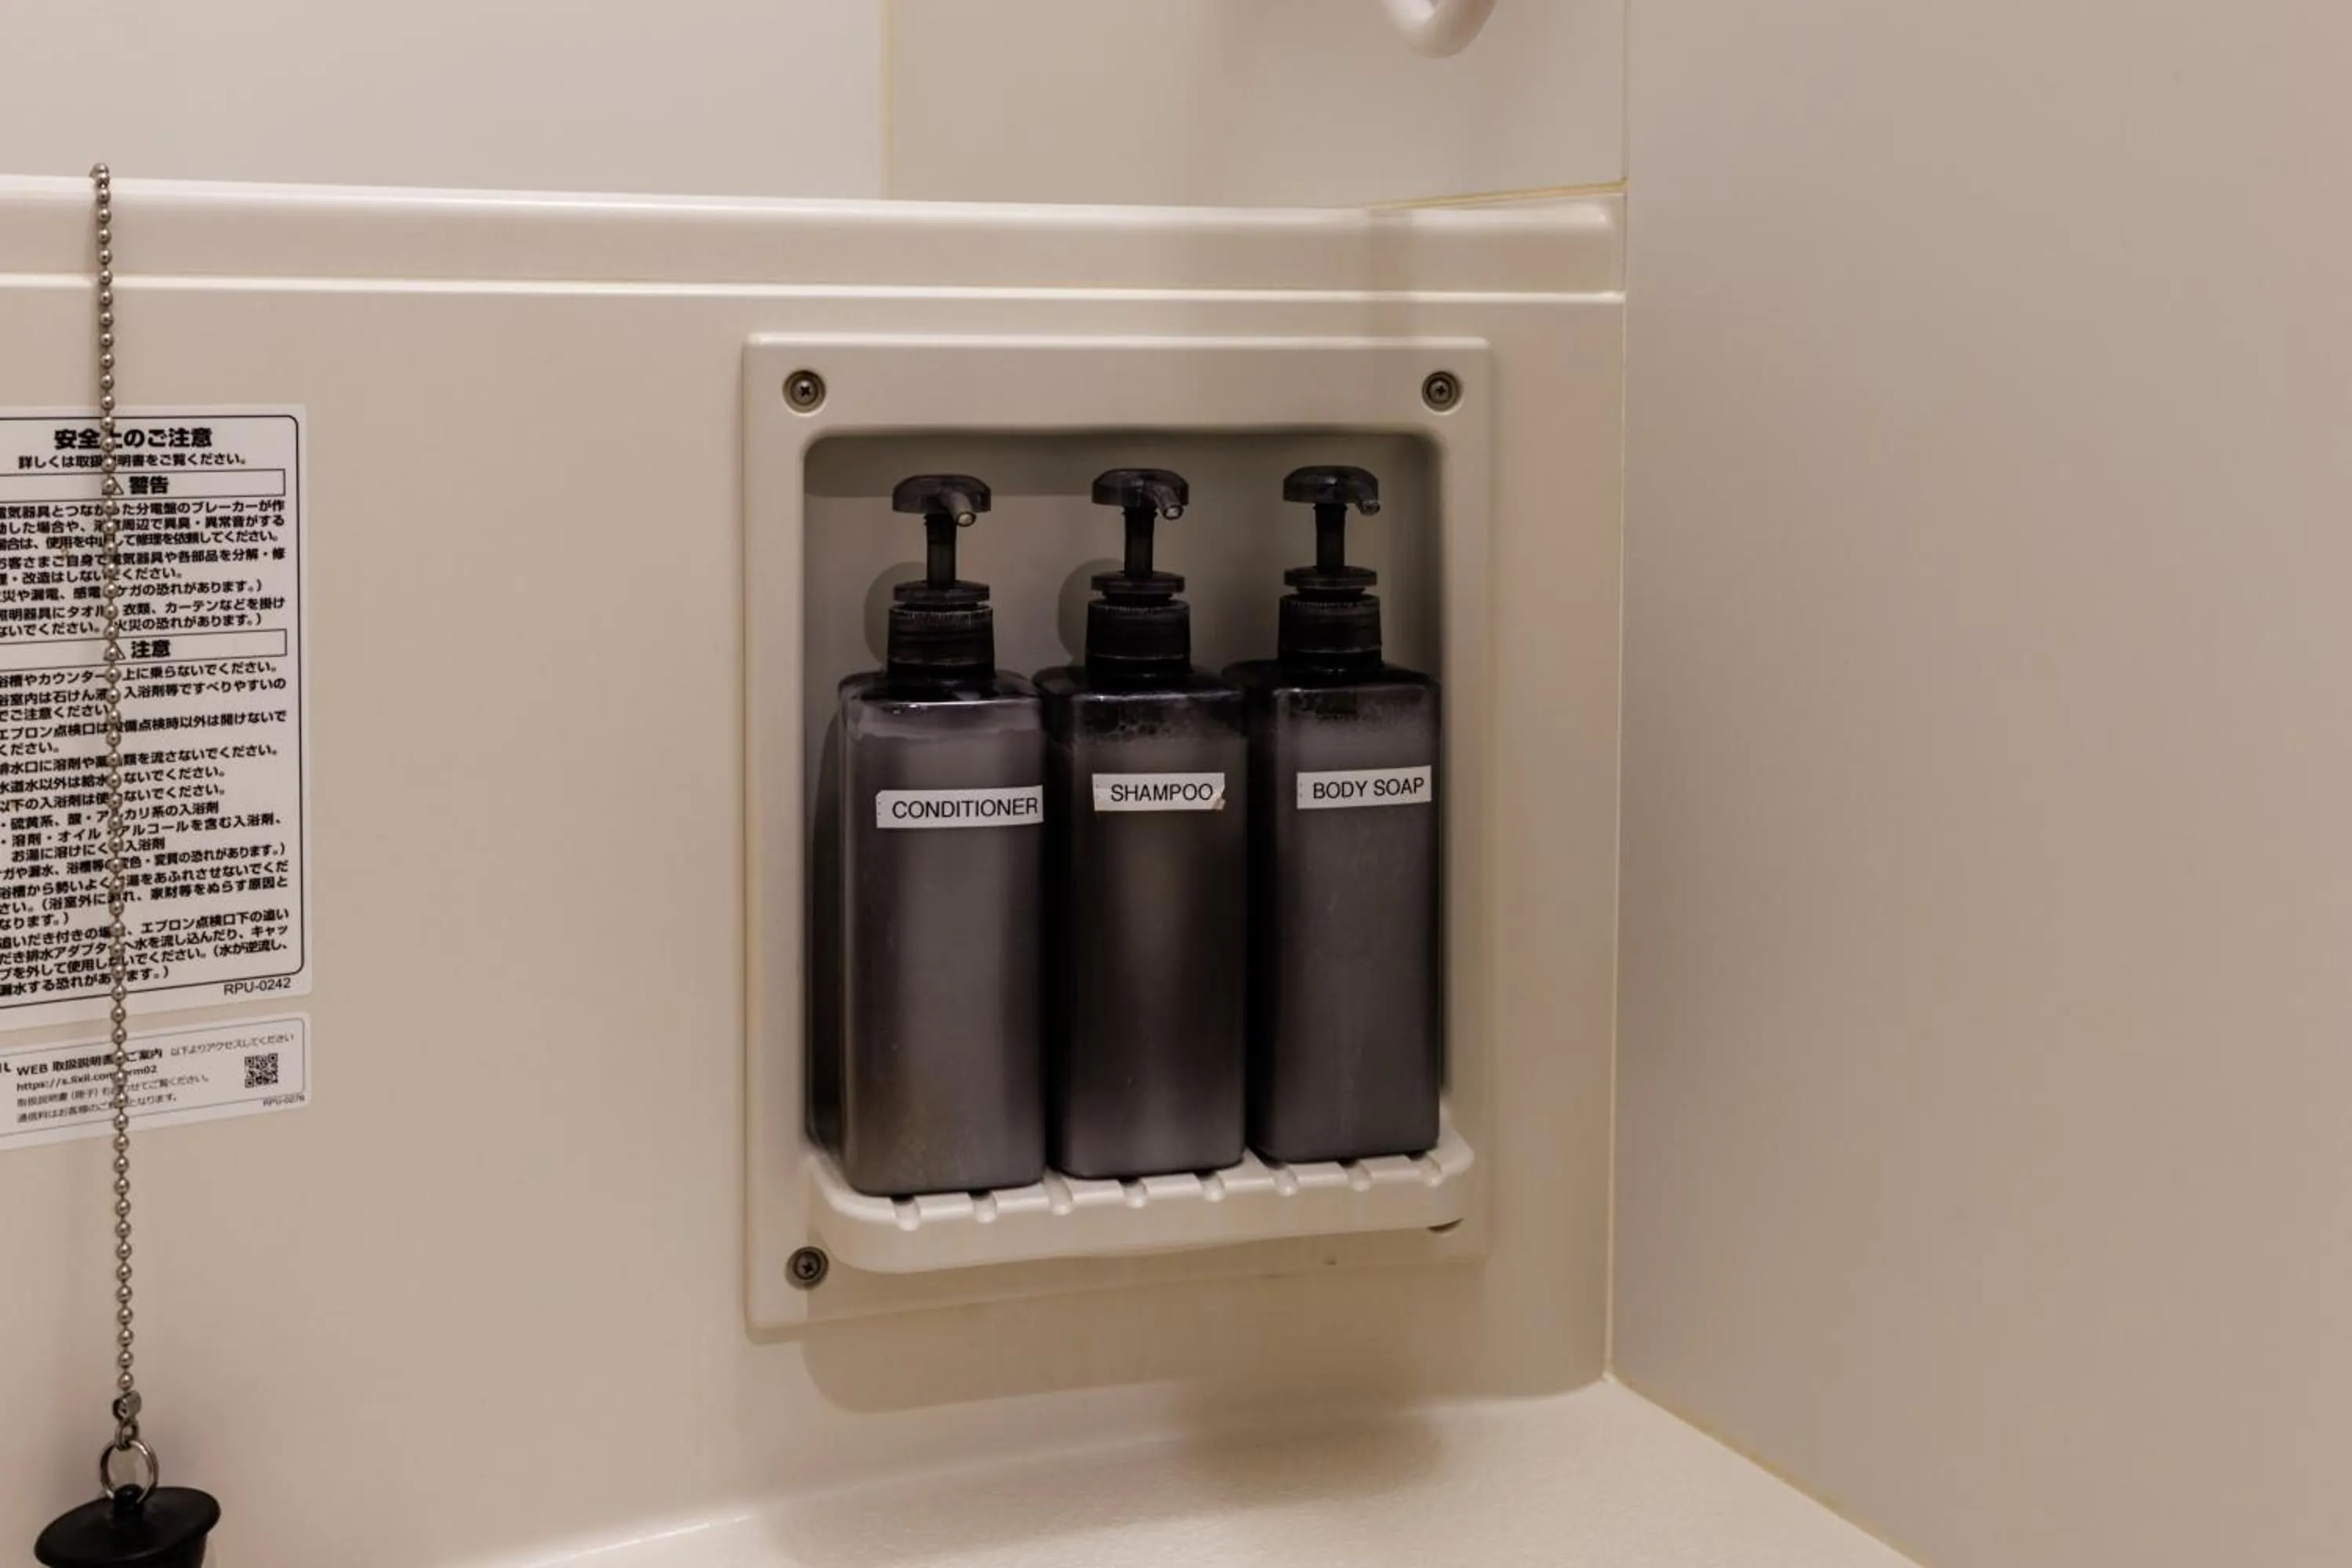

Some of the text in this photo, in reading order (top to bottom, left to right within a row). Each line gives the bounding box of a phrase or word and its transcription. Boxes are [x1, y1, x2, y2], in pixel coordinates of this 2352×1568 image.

[18, 452, 245, 470] 詳しくは取扱明書をご覧ください。
[129, 475, 169, 495] 警告
[0, 499, 285, 519] 気器具とつながた分電盤のブレーカーが作
[0, 597, 285, 621] 照明器具にタオル衣類、カーテンなどを掛け
[131, 639, 170, 657] 注意
[0, 661, 276, 688] 浴槽やカウンター上に乗らないでください。
[0, 677, 286, 706] 浴室内は石けん液入浴剤等ですべりやすいの
[0, 744, 278, 775] 排水口に溶剤や薬類を流さないでください。
[0, 766, 225, 794] 水道水以外は給水ないでください。
[1111, 783, 1214, 802] SHAMPOO
[1313, 777, 1425, 799] BODY SOAP
[0, 784, 225, 812] 以下の入浴剤は使ないでください。
[892, 797, 1038, 819] CONDITIONER
[2, 800, 219, 830] ・硫黄系、酸・アカリ系の入浴剤
[12, 837, 165, 863] お湯に溶けにく入浴剤
[0, 860, 289, 899] 浴槽から勢いよく湯をあふれさせないでくだ
[0, 908, 289, 949] 追いだき付きの場、エプロン点検口下の追い
[0, 925, 288, 965] だき排水アダプタへ水を流し込んだり、キャッ
[0, 966, 169, 996] 漏水する恐れがあます。）
[223, 977, 291, 996] RPU-0242
[16, 1063, 49, 1076] WEB
[53, 1047, 162, 1072] 取扱説明書ご案内
